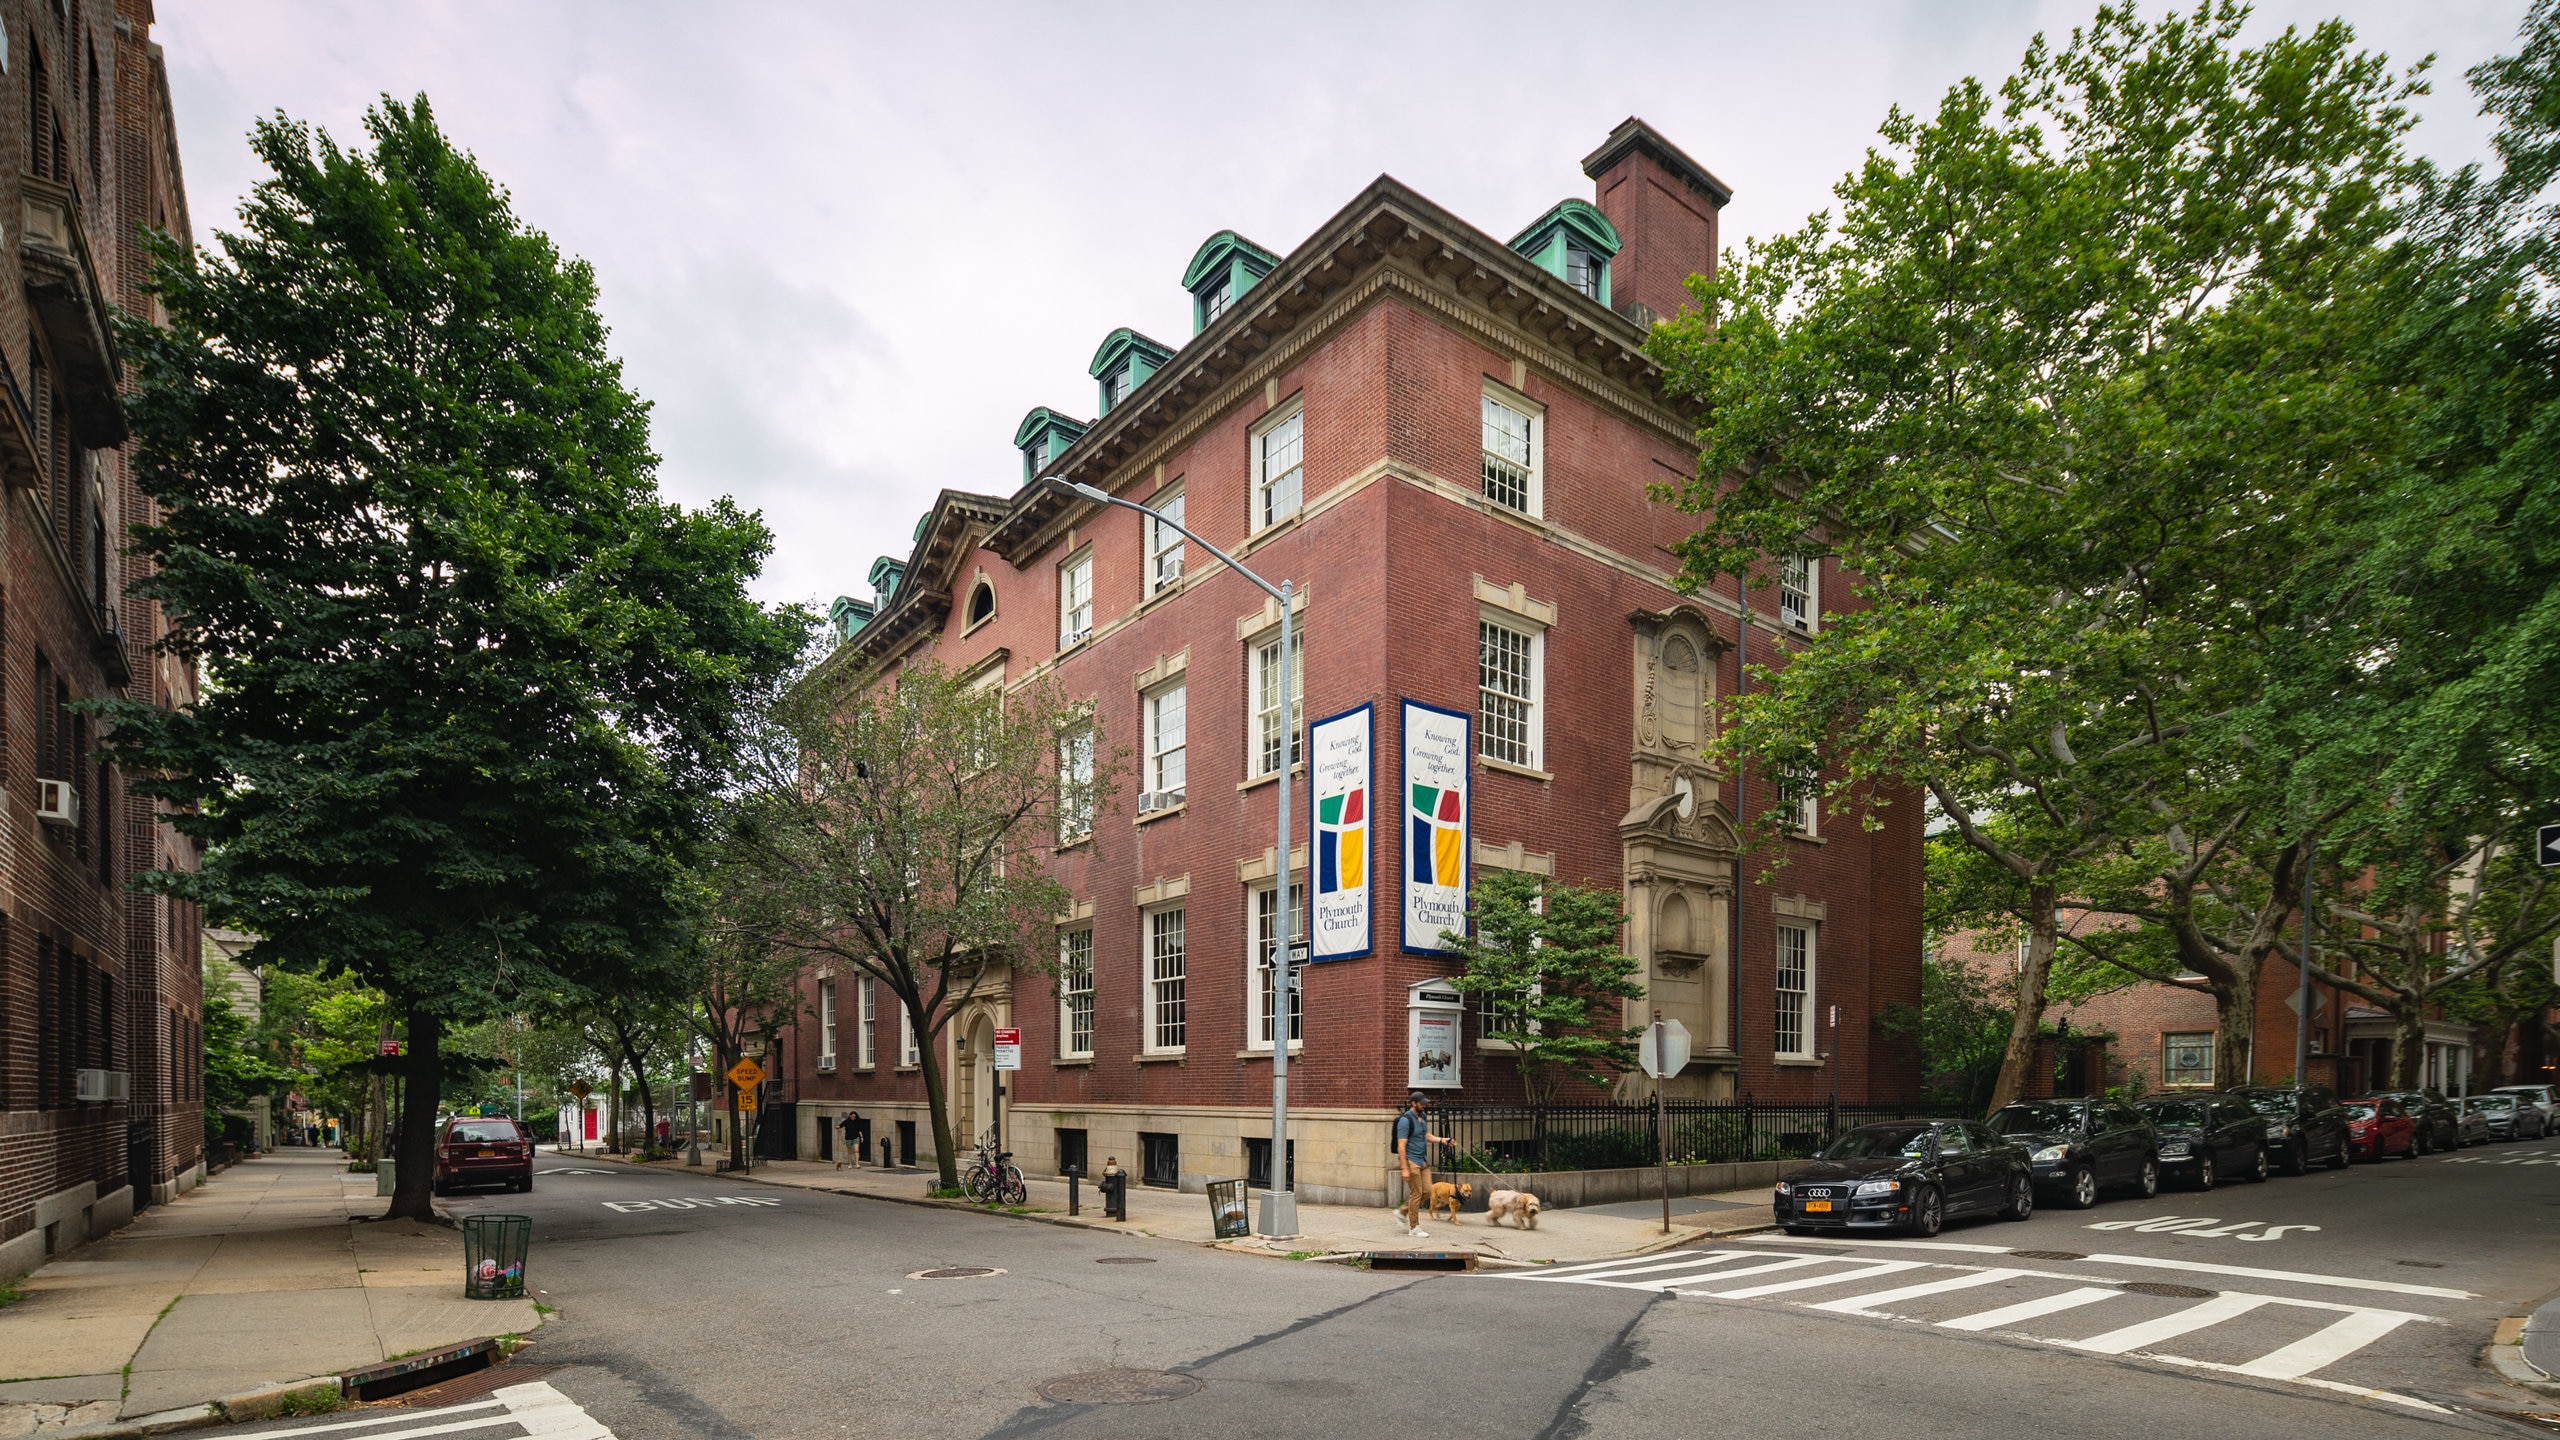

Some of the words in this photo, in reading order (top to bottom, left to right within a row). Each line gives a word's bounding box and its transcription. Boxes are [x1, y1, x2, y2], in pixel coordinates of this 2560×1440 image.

[1329, 735, 1359, 751] Knowing
[1424, 729, 1457, 747] Knowing
[1412, 746, 1443, 765] Growing
[1319, 900, 1363, 919] Plymouth
[1413, 896, 1460, 913] Plymouth
[1323, 914, 1358, 931] Church
[1418, 910, 1454, 926] Church
[1291, 949, 1305, 960] WAY
[741, 1096, 753, 1104] 15
[601, 1196, 782, 1213] BUMP
[2081, 1216, 2321, 1241] STOP
